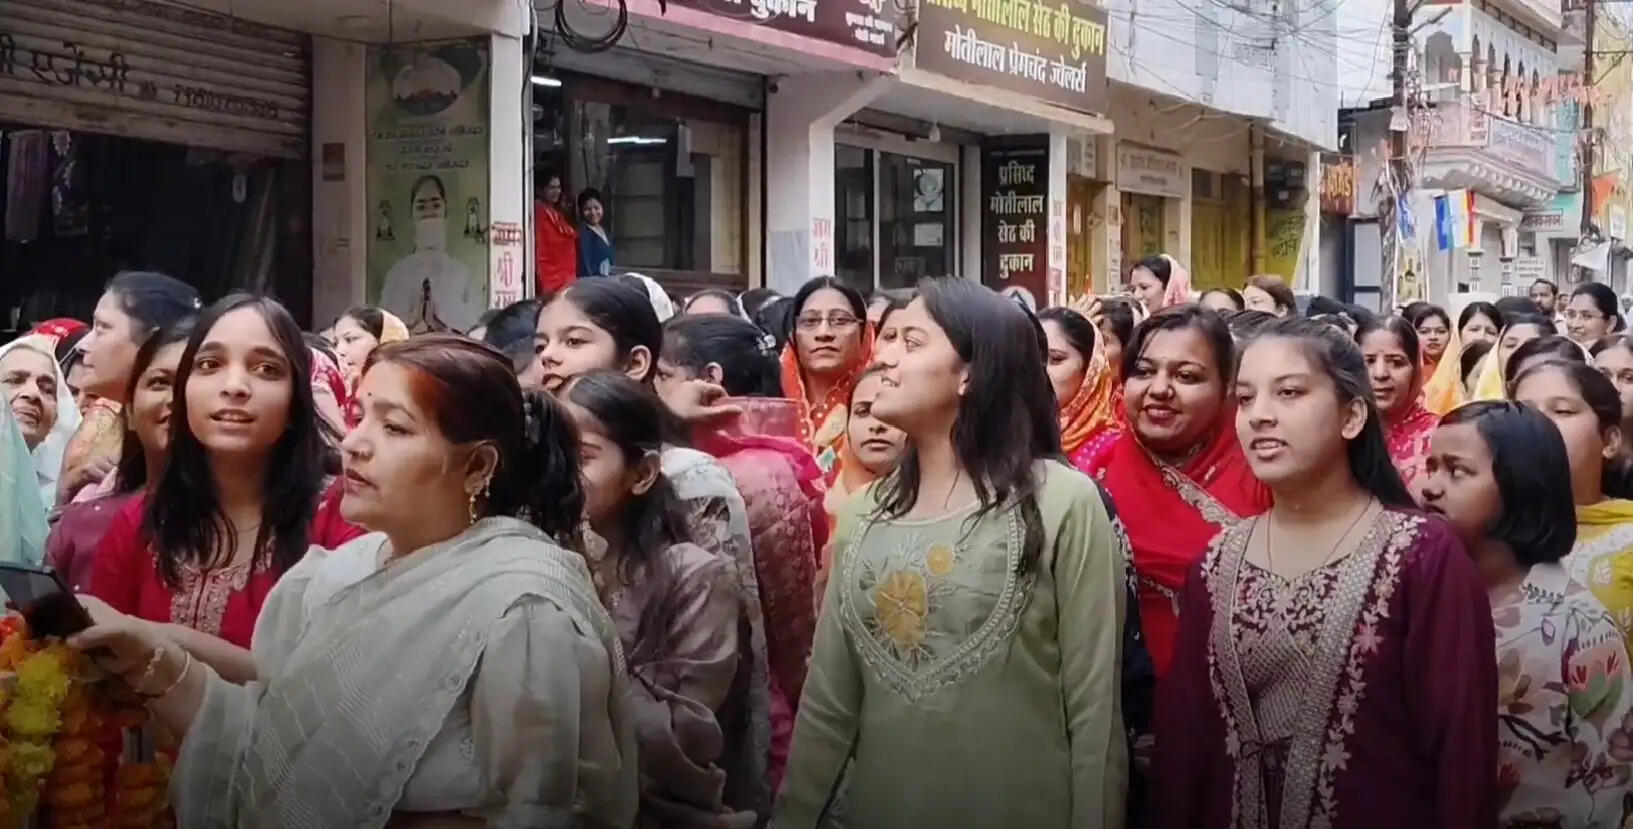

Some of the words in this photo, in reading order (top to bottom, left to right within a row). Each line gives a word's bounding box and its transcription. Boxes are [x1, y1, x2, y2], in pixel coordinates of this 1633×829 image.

[1053, 3, 1071, 45] की
[1071, 16, 1105, 60] दुकान
[944, 24, 1006, 72] मोतीलाल
[989, 190, 1046, 215] मोतीलाल
[998, 220, 1017, 243] सेठ
[1019, 218, 1036, 243] की
[999, 253, 1035, 279] दुकान
